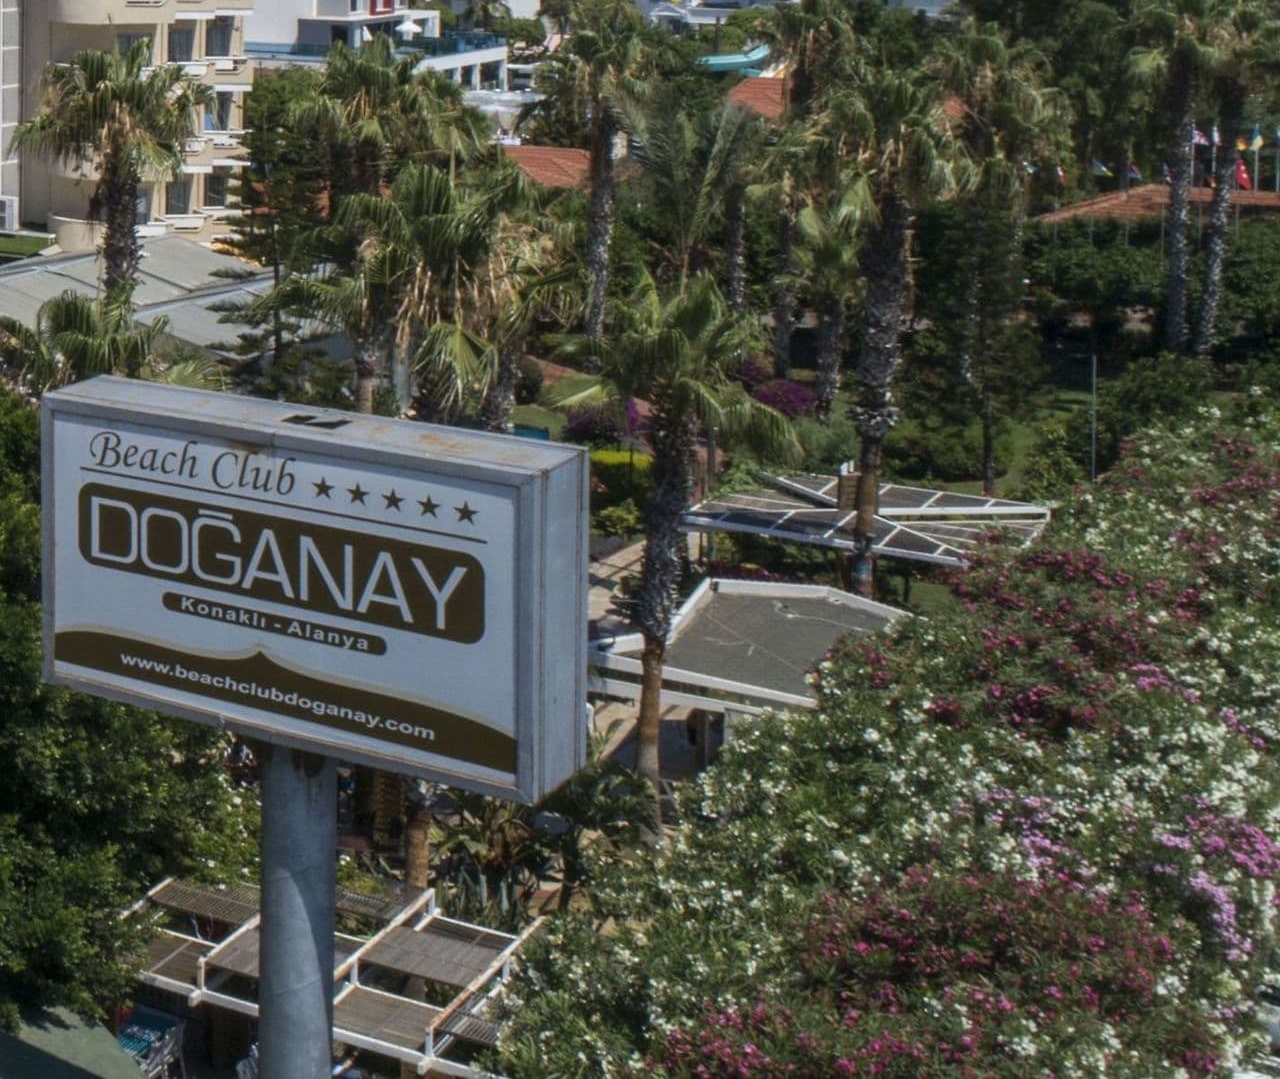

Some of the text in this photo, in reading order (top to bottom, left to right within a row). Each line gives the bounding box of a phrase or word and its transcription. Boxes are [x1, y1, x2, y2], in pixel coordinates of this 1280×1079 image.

[90, 431, 297, 496] Beach Club
[180, 596, 266, 628] Konaklı
[288, 621, 369, 652] Alanya
[120, 652, 436, 742] www.beachclubdoganay.com
